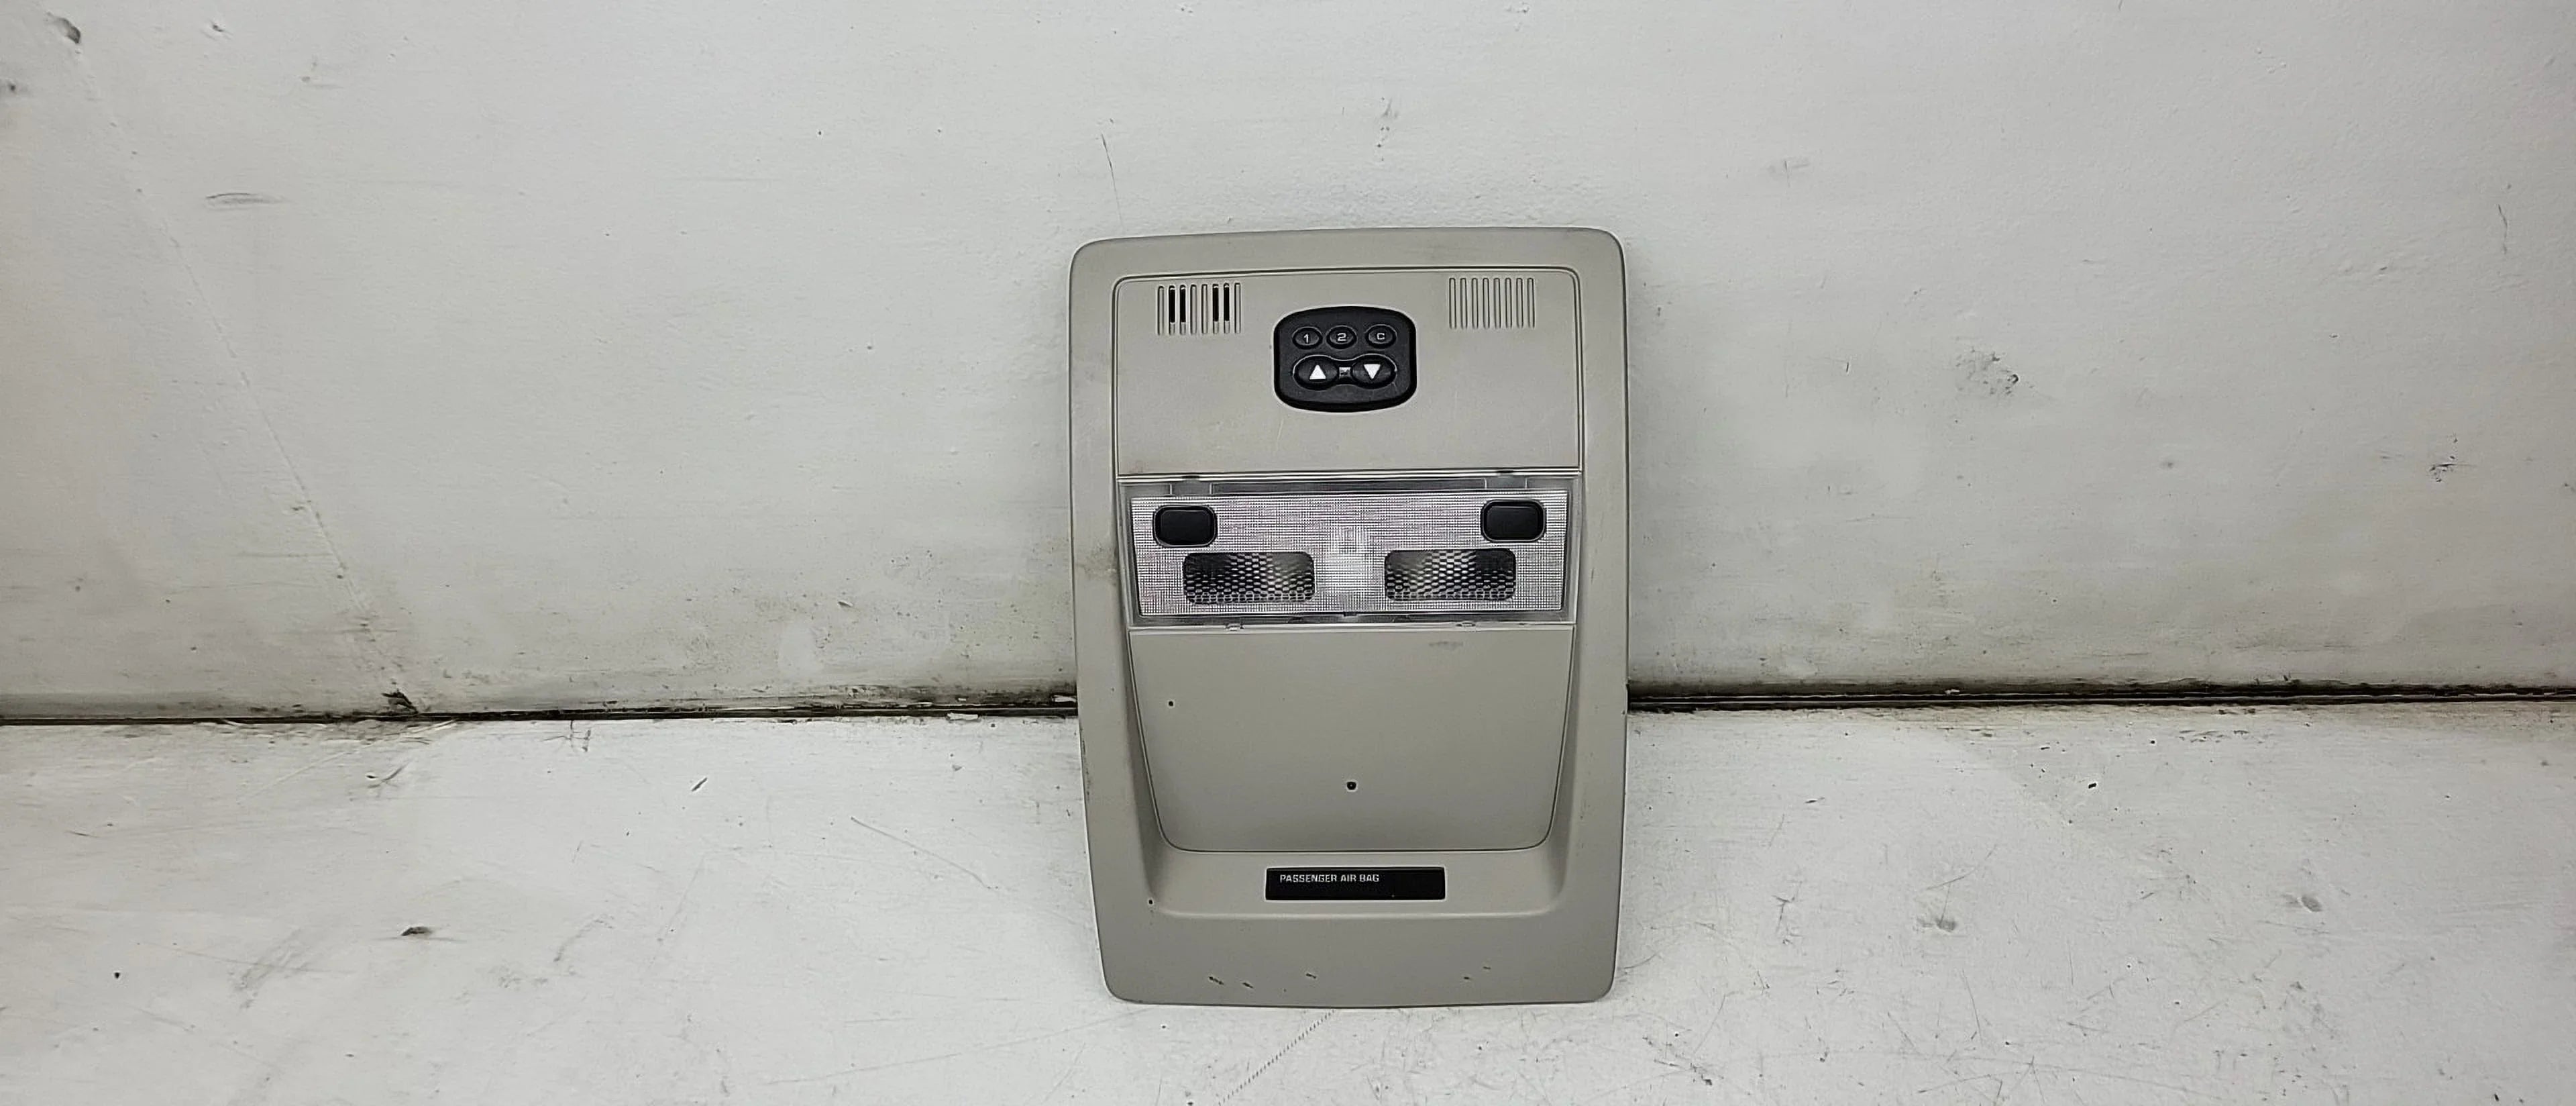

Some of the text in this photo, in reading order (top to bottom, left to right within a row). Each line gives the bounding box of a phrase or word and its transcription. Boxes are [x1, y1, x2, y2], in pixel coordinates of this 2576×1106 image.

[1303, 332, 1385, 343] 1 2 C
[1279, 874, 1379, 883] PASSENGER AIR BAG
